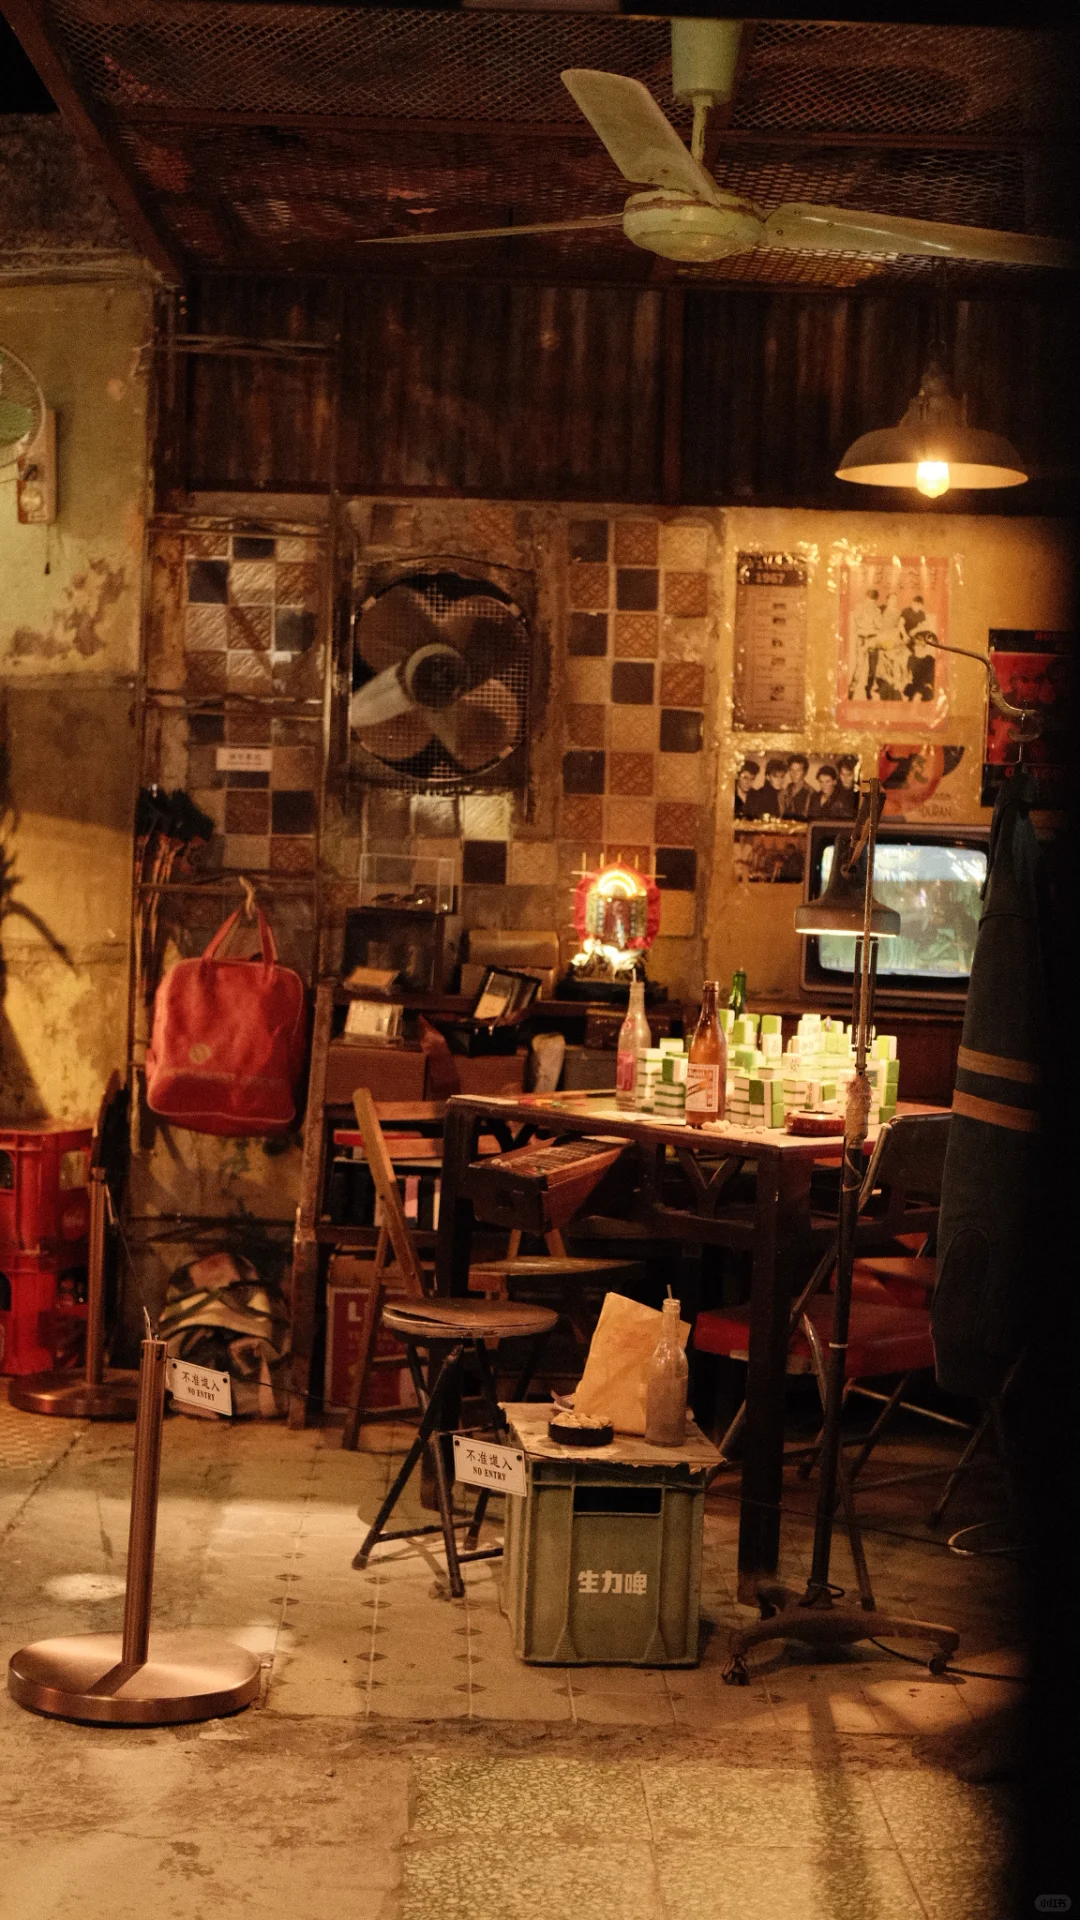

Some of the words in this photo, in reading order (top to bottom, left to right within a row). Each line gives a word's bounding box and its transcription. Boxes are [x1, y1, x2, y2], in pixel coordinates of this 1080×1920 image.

[182, 1371, 220, 1392] 不准進入
[187, 1386, 196, 1396] NO
[196, 1389, 216, 1402] ENTRY
[466, 1449, 513, 1471] 不准進入
[472, 1466, 483, 1476] NO
[484, 1469, 506, 1481] ENTRY
[577, 1570, 648, 1595] 生力啤
